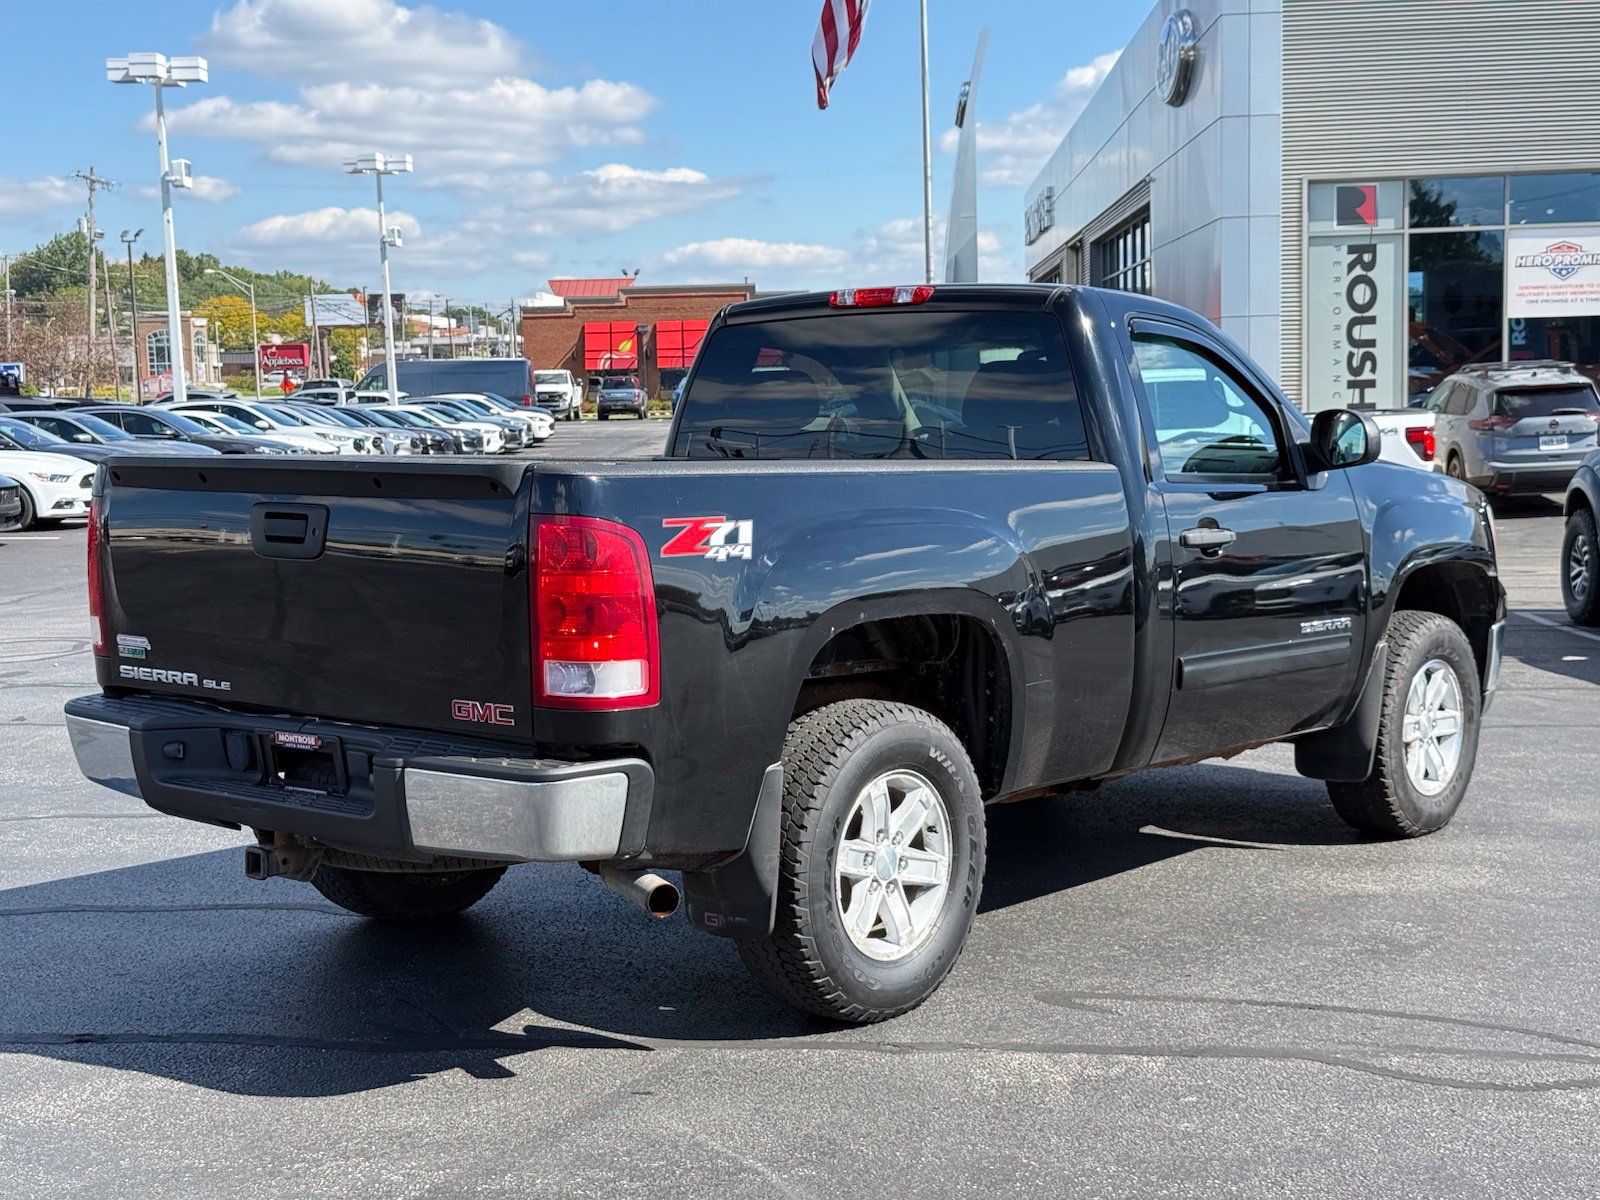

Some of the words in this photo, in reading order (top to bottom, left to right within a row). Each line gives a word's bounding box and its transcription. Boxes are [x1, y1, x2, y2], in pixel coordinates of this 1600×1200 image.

[1515, 255, 1553, 268] HERO
[1332, 245, 1342, 399] PERFORMANC
[1346, 243, 1378, 410] ROUSH
[661, 516, 753, 558] Z71
[120, 665, 199, 686] SIERRA
[203, 680, 231, 691] SLE
[451, 699, 515, 726] GMC
[278, 733, 316, 745] MONTROSE
